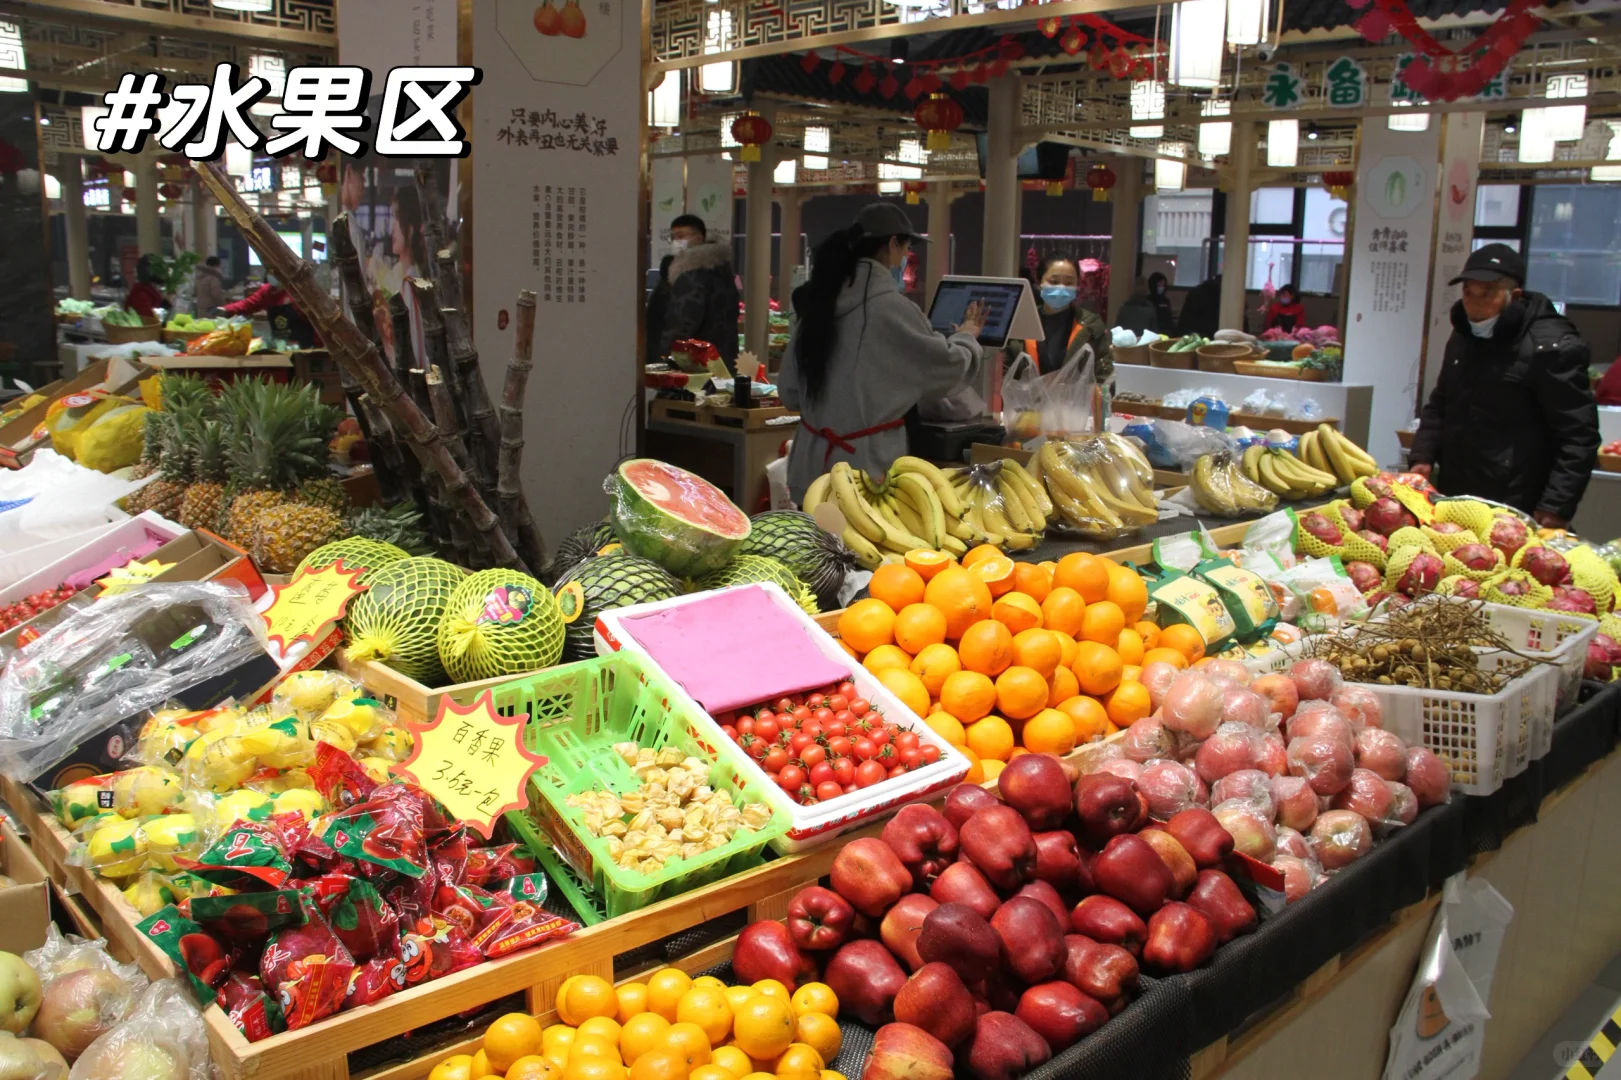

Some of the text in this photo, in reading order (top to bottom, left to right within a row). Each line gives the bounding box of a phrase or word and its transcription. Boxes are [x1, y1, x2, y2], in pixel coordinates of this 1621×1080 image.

[510, 107, 607, 137] 只要内心美好
[497, 126, 619, 156] 外表再丑也无关紧要
[452, 720, 505, 767] 百香果
